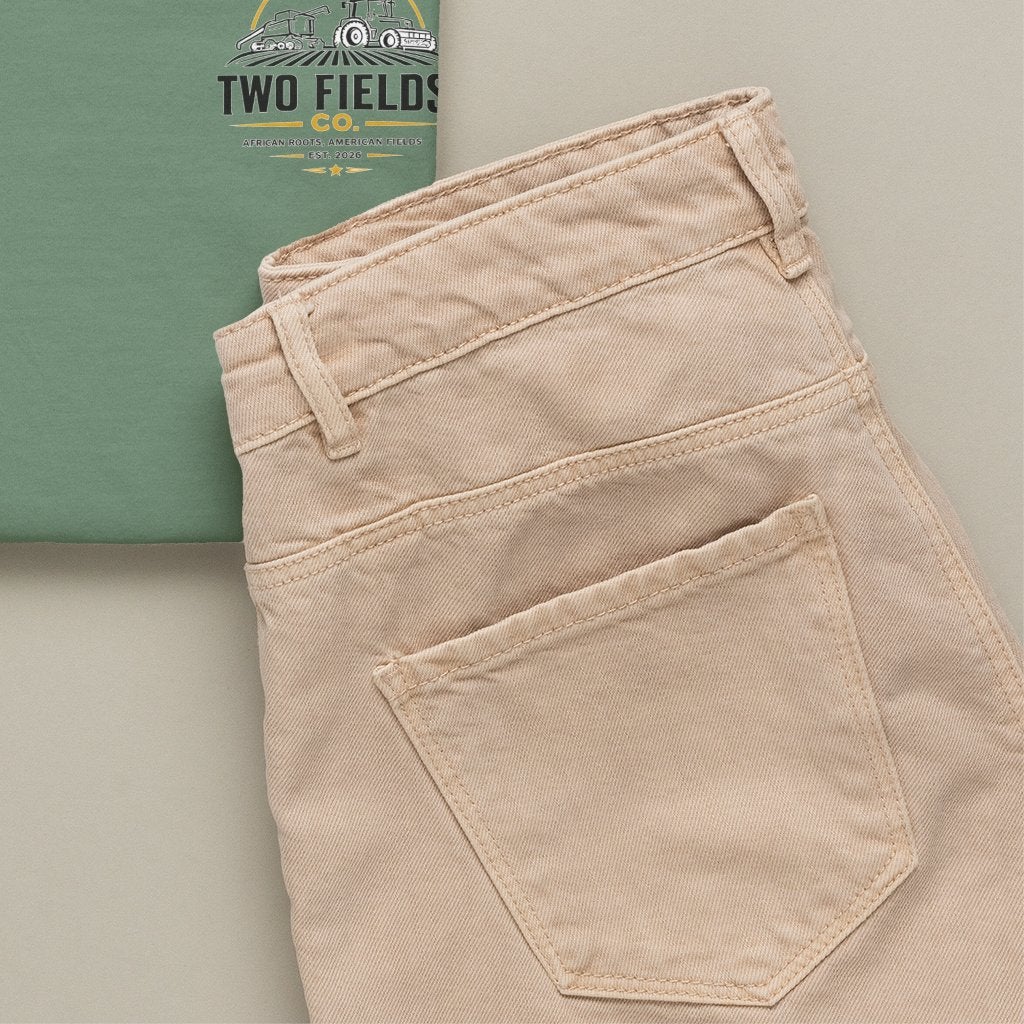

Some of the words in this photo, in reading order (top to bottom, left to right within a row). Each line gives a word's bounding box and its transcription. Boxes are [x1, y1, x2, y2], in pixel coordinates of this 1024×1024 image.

[217, 74, 298, 115] TWO
[311, 112, 360, 132] CO.
[243, 139, 285, 147] AFRICAN
[288, 138, 325, 147] ROOTS,
[328, 138, 383, 146] AMERICAN
[386, 138, 422, 146] FIELDS
[308, 151, 332, 159] EST.
[335, 151, 362, 159] 2026
